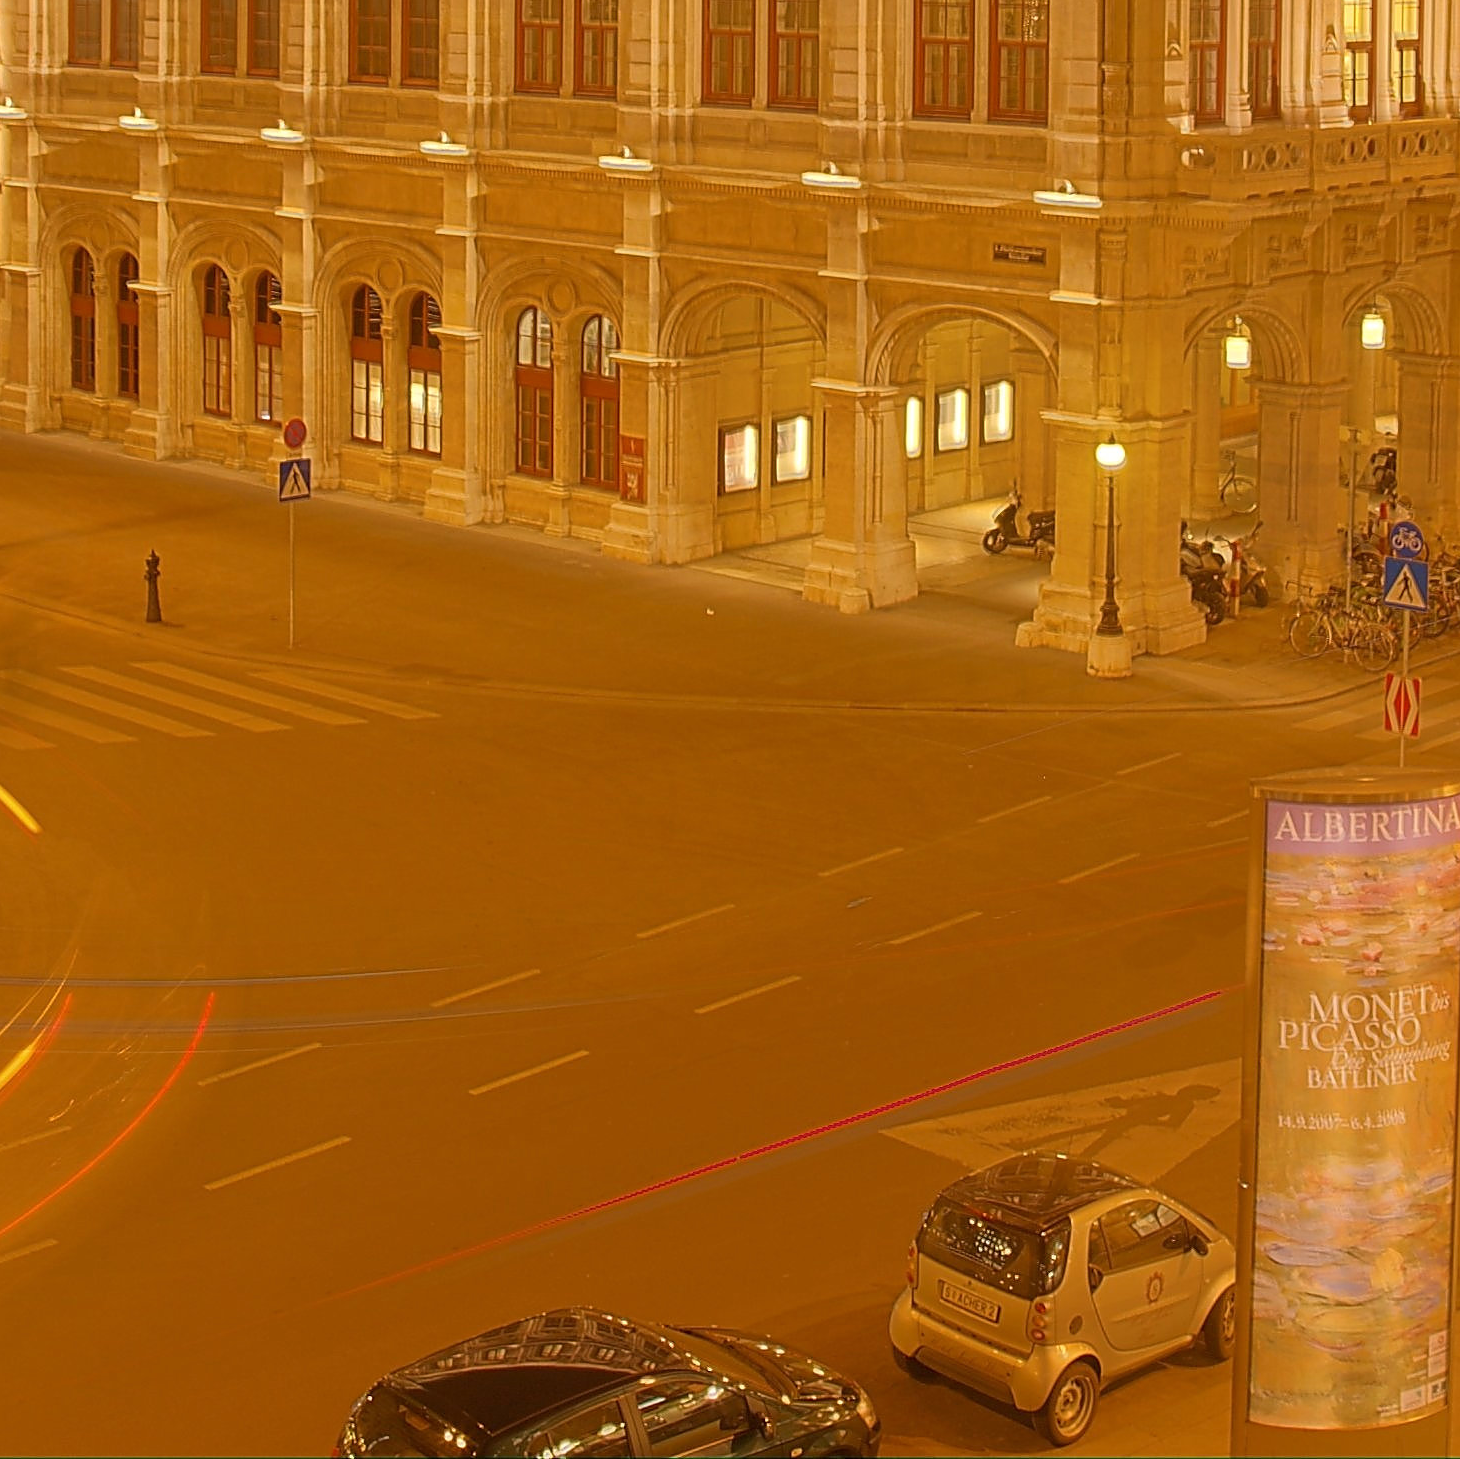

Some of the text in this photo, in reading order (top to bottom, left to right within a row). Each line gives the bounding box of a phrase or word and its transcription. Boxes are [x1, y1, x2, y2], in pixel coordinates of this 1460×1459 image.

[1308, 982, 1451, 1024] MONET bis
[1278, 1016, 1421, 1052] PICASSO
[1331, 1044, 1365, 1071] Die
[1307, 1062, 1417, 1090] BATLINER
